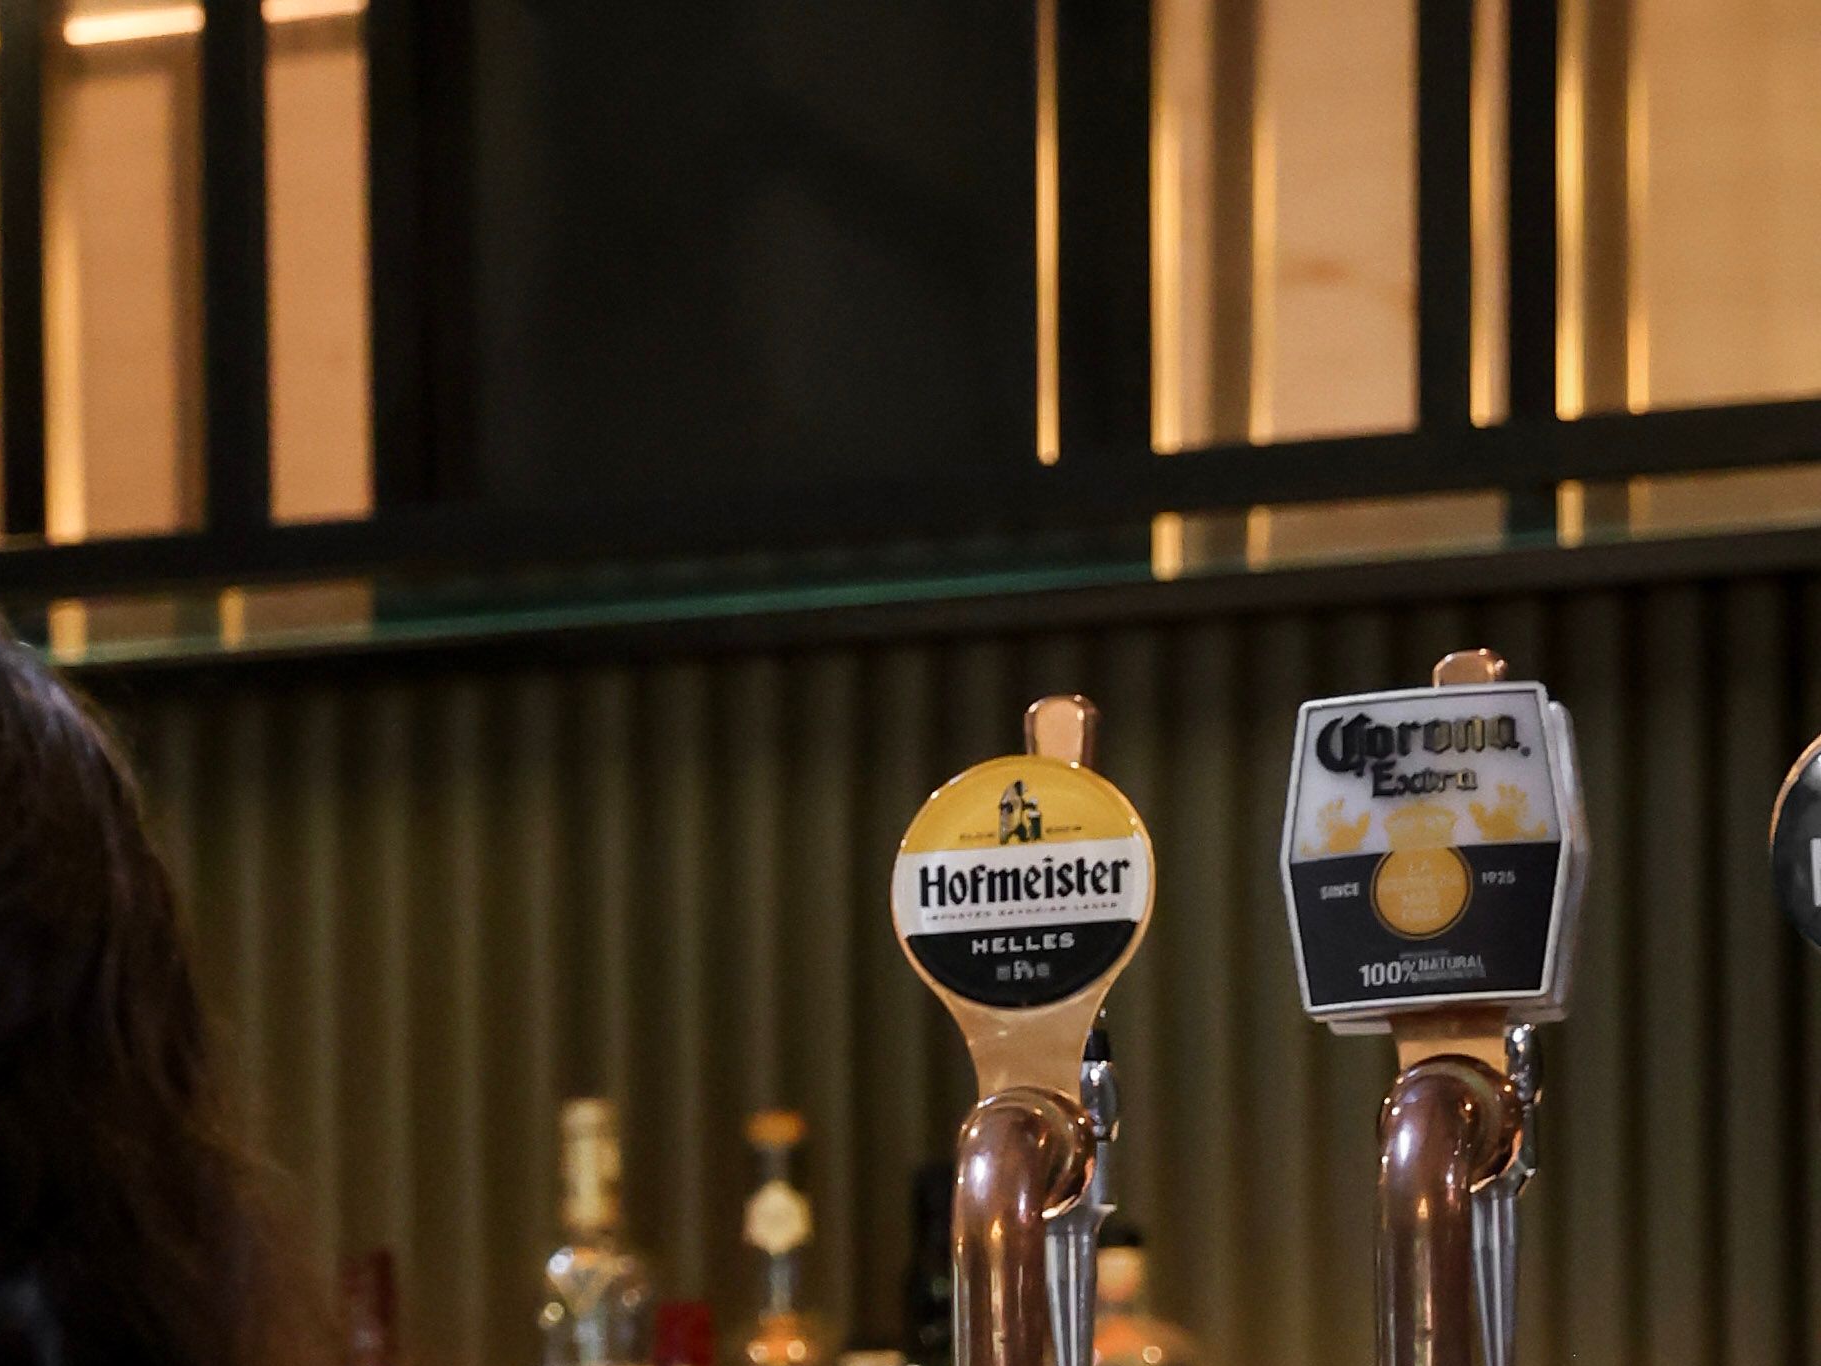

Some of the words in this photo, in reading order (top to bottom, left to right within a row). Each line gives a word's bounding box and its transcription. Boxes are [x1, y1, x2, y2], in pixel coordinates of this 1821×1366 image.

[1316, 713, 1520, 778] Corona
[1371, 760, 1478, 798] Extra
[919, 855, 1131, 908] Hofmeister
[1319, 882, 1360, 900] SINCE
[1481, 869, 1516, 885] 1925
[971, 932, 1076, 956] HELLES
[1358, 958, 1418, 988] 100%
[1418, 954, 1484, 972] NATURAL
